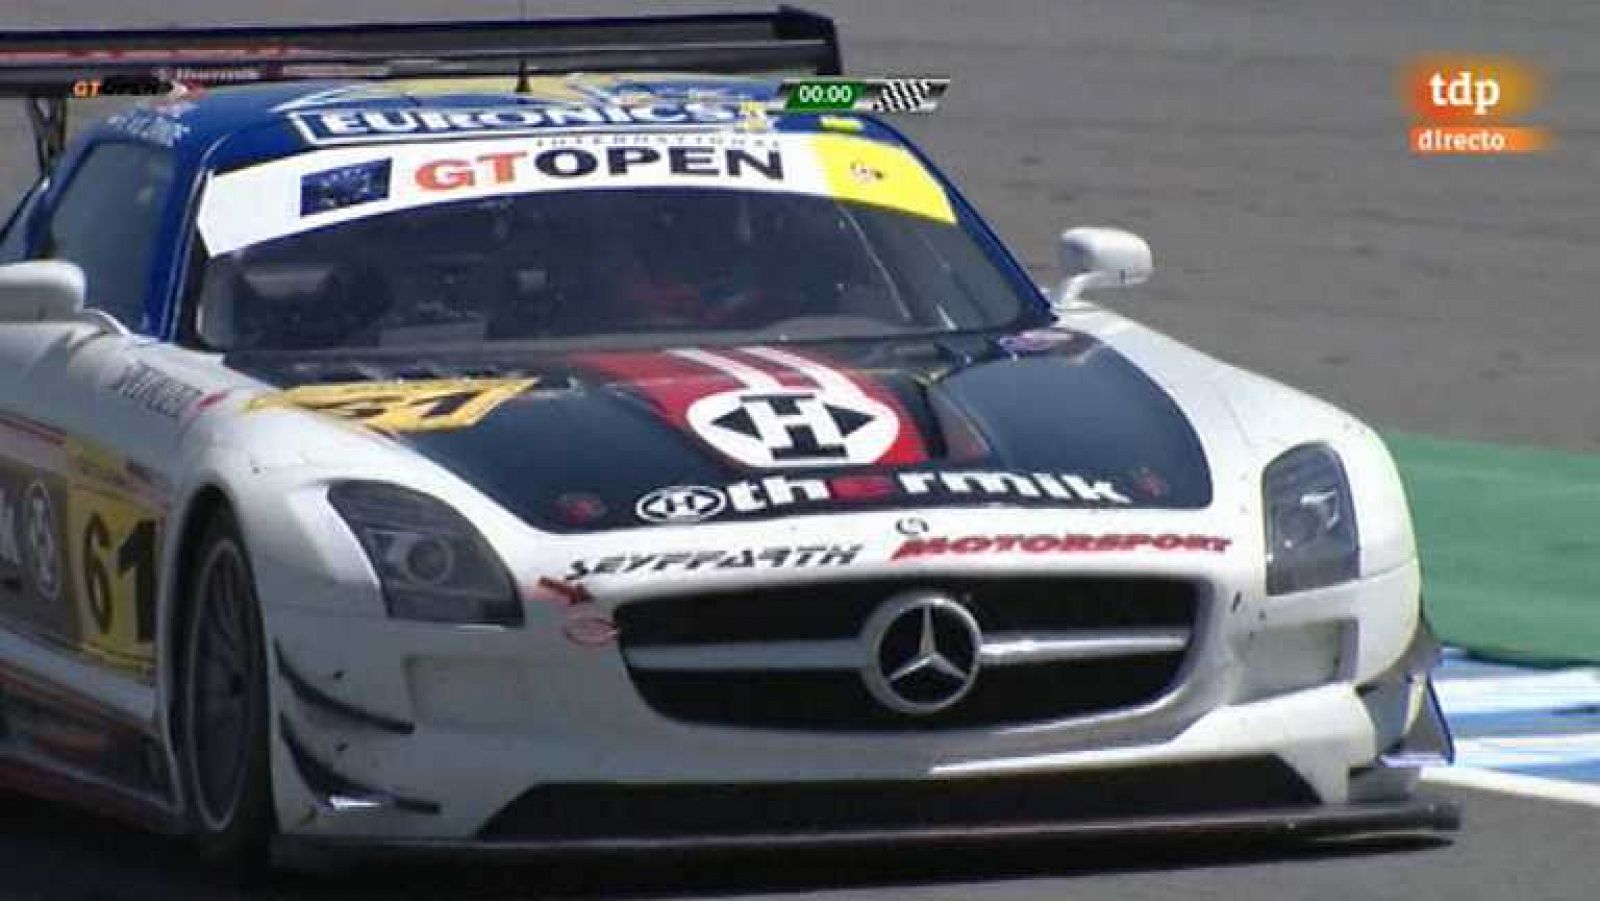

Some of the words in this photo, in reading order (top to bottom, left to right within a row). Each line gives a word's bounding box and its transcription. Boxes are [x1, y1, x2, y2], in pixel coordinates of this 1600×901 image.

[727, 468, 1133, 512] thermik
[565, 545, 863, 580] SEYFFARTH
[891, 533, 1233, 561] MOTORSPORT
[83, 511, 156, 643] 61
